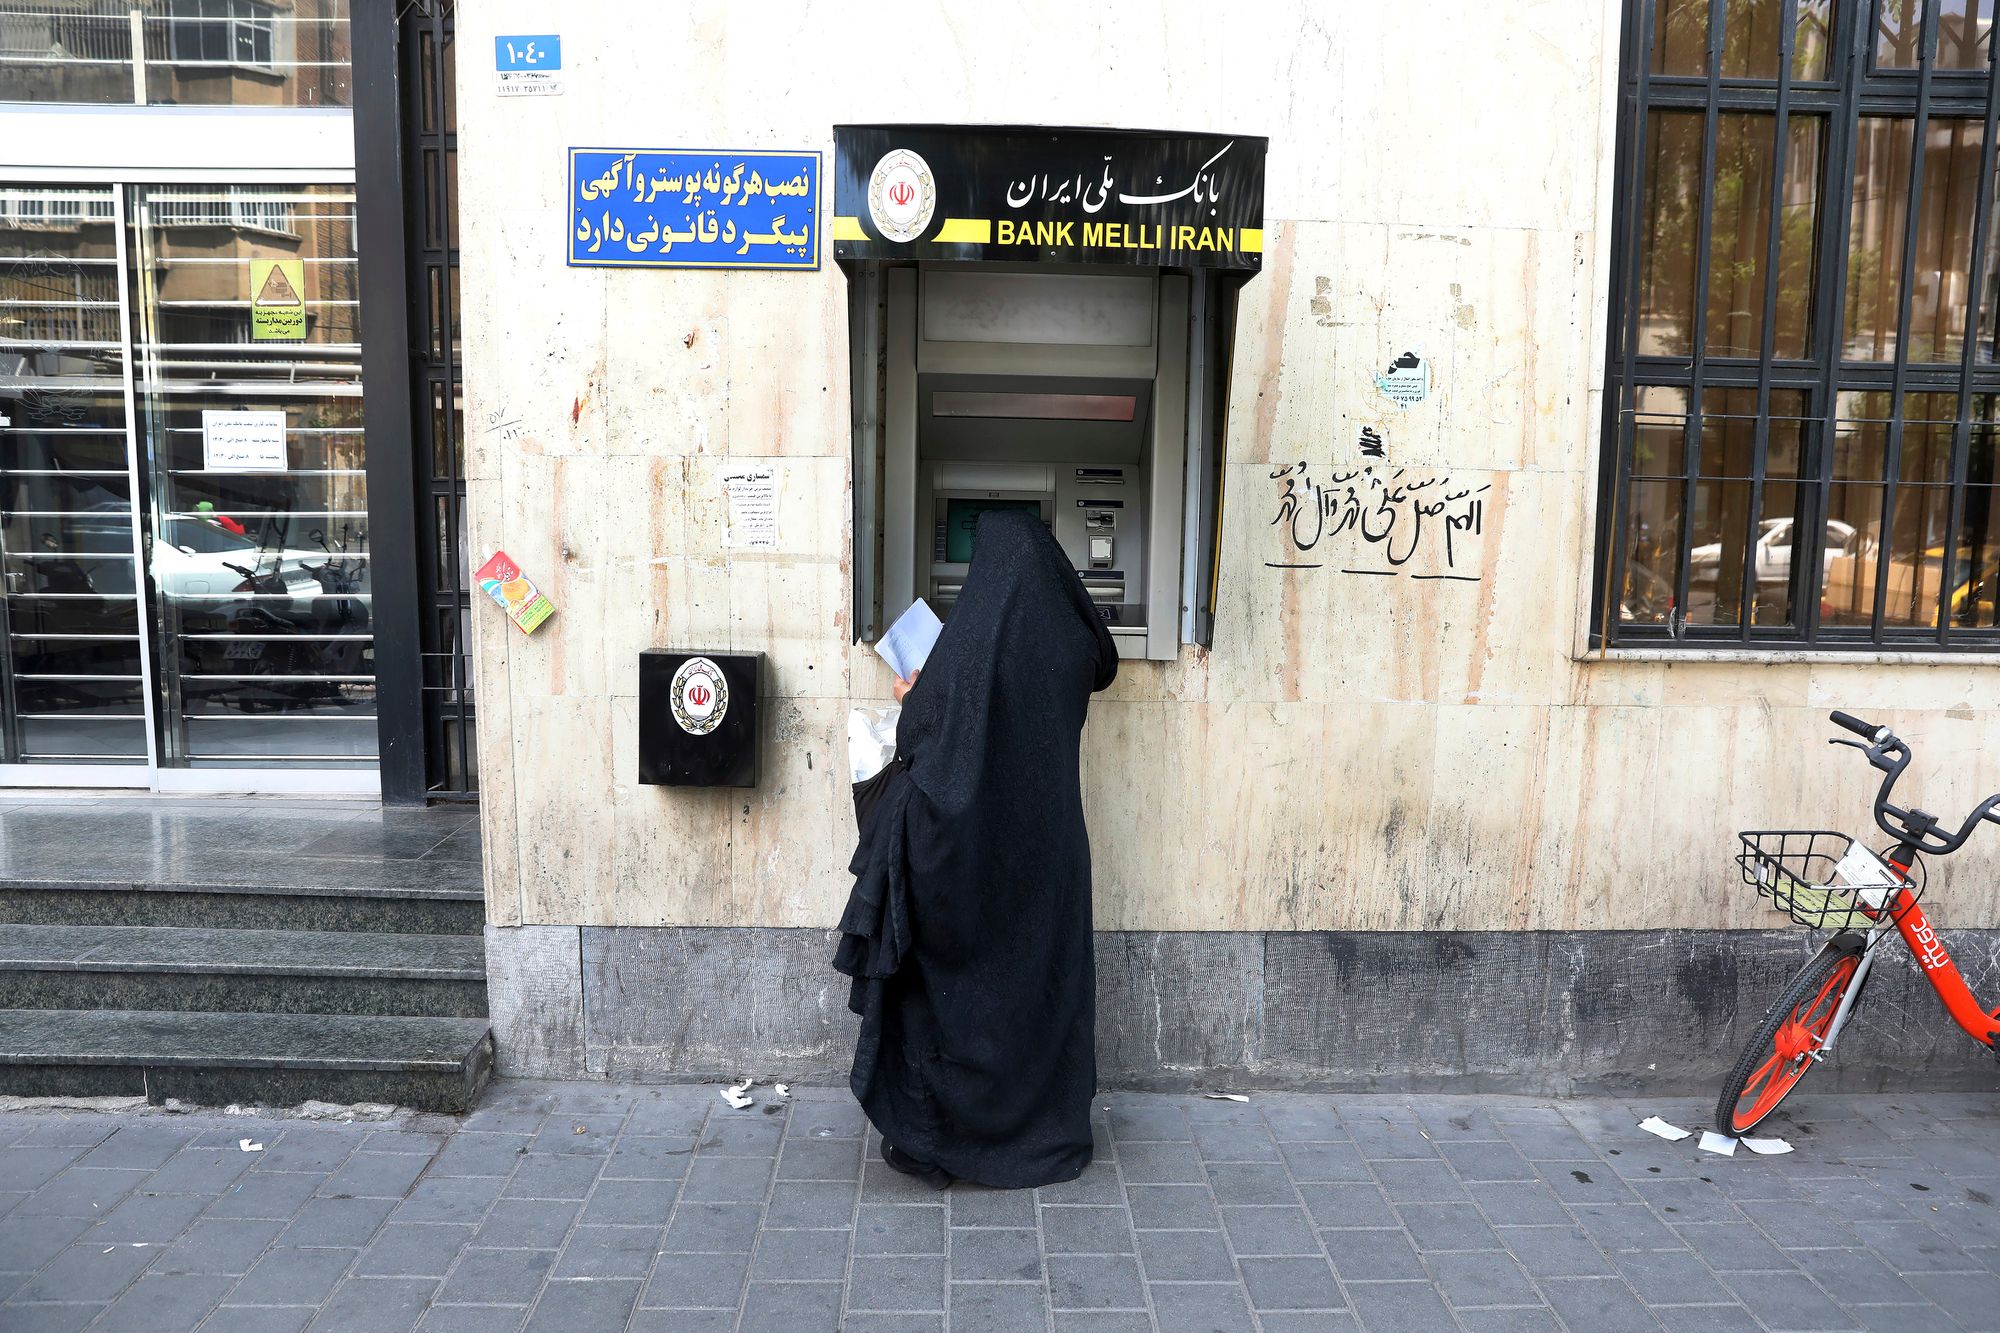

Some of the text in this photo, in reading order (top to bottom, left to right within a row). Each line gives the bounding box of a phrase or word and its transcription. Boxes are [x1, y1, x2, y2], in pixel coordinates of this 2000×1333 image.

[580, 153, 638, 201] آگهی
[633, 172, 645, 203] و
[645, 166, 702, 208] پوستر
[764, 166, 810, 206] نصب
[1007, 173, 1081, 209] ایران
[576, 209, 809, 259] پیگرد قانونی دارد
[998, 219, 1234, 252] BANK MELLI IRAN
